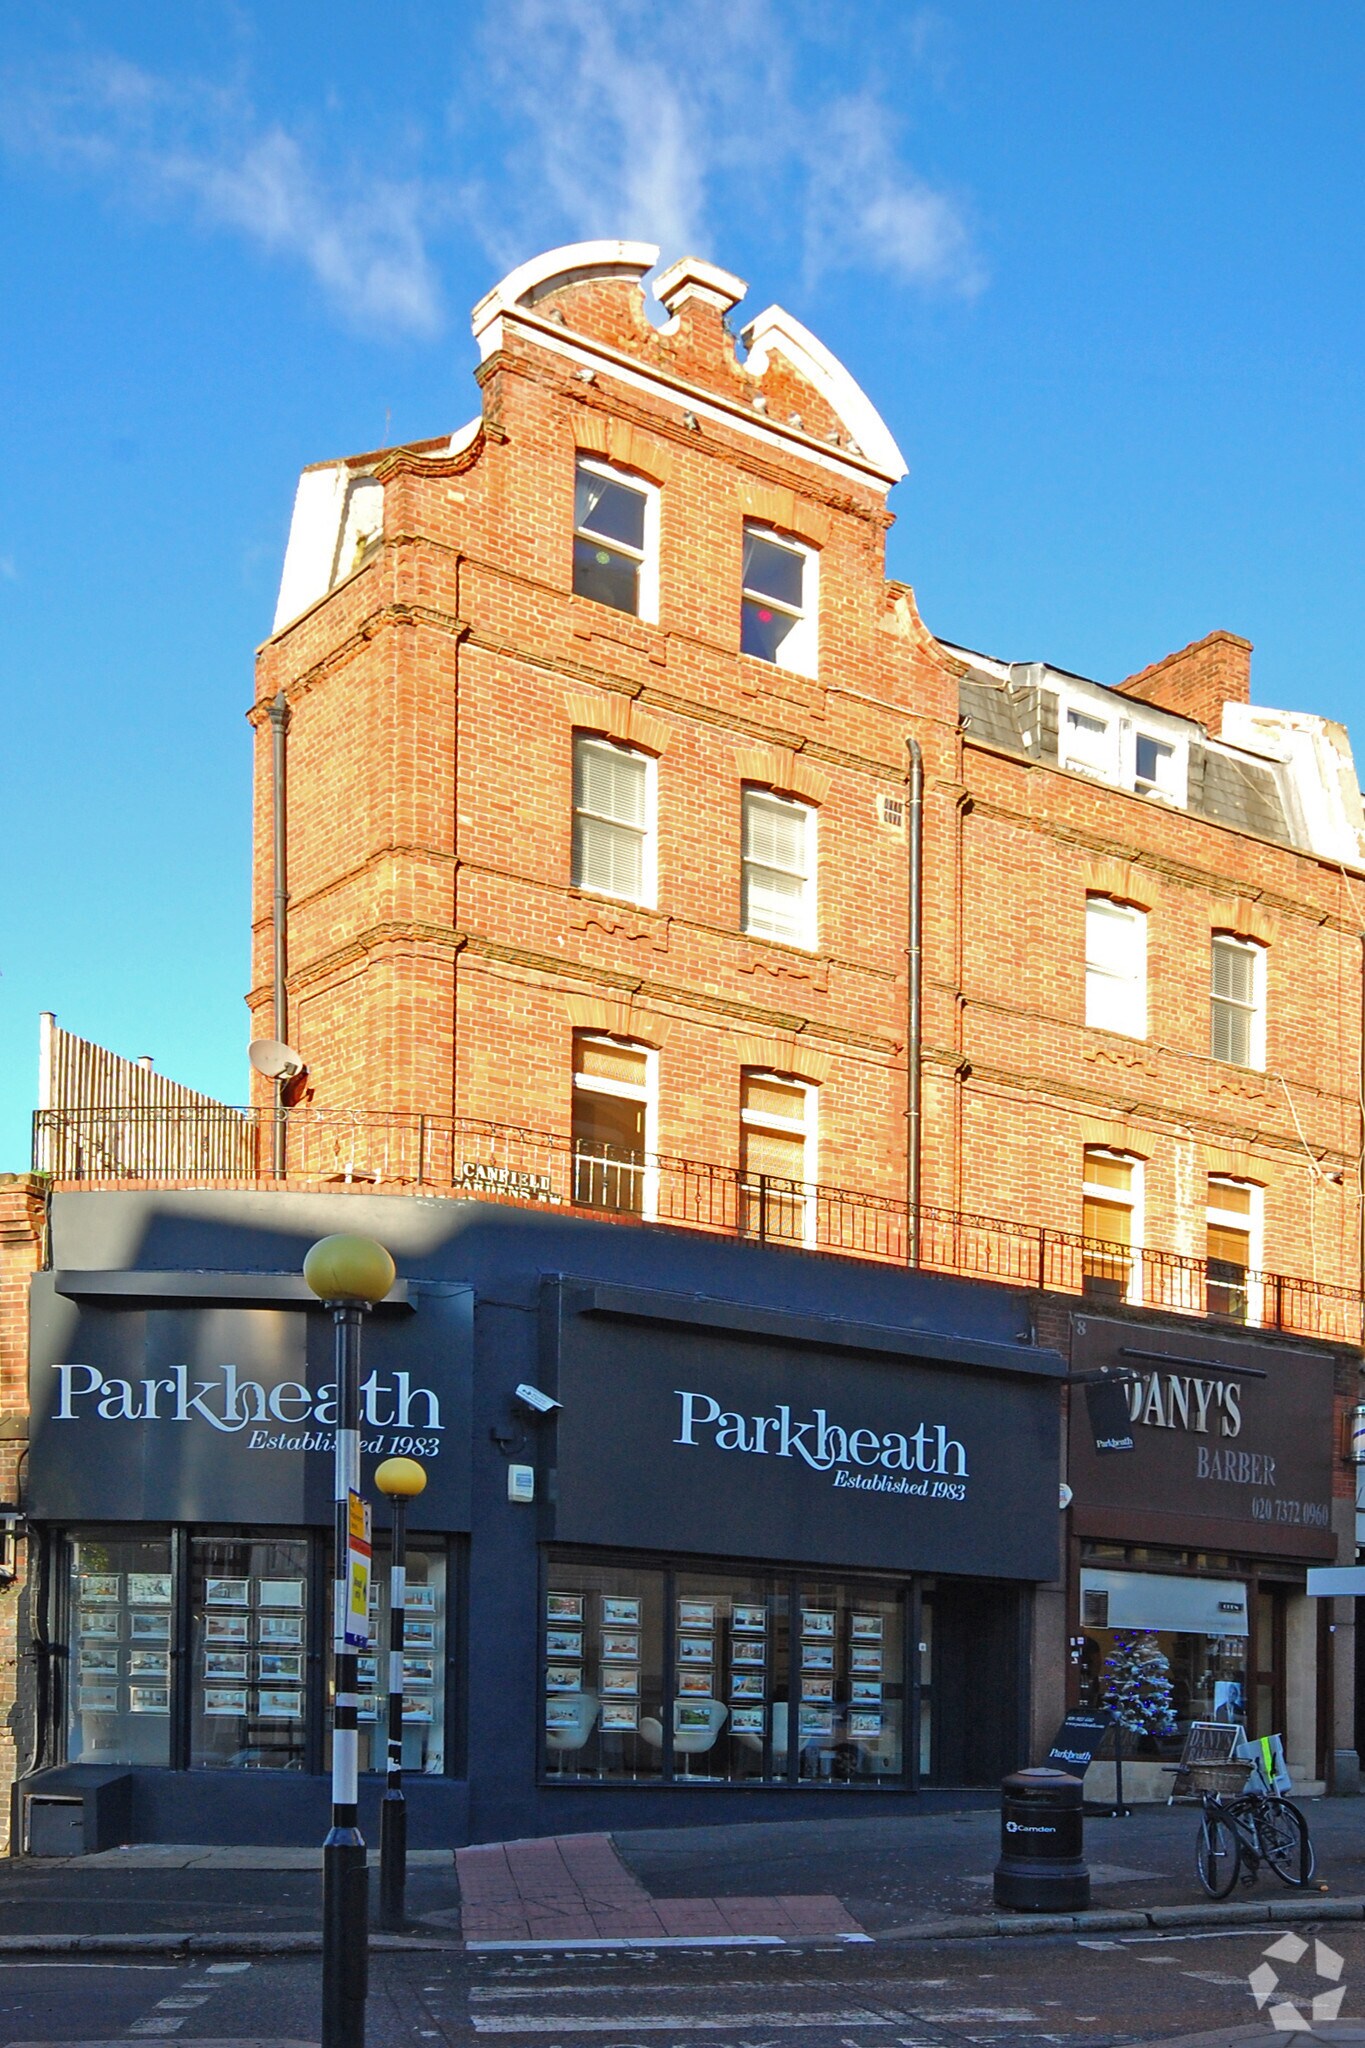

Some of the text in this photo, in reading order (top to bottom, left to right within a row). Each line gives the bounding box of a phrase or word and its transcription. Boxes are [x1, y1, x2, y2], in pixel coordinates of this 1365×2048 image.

[463, 1162, 550, 1190] CANFIELD
[1077, 1321, 1086, 1335] 8
[51, 1364, 445, 1432] Parkheath
[247, 1430, 440, 1457] Establied 1983
[672, 1390, 970, 1477] Parkheath
[1197, 1446, 1276, 1486] BARBER
[832, 1470, 966, 1501] Established 1983
[1252, 1497, 1272, 1520] 020
[1274, 1499, 1300, 1523] 7372
[1049, 1748, 1092, 1761] Parkheath
[1017, 1824, 1056, 1833] Camden
